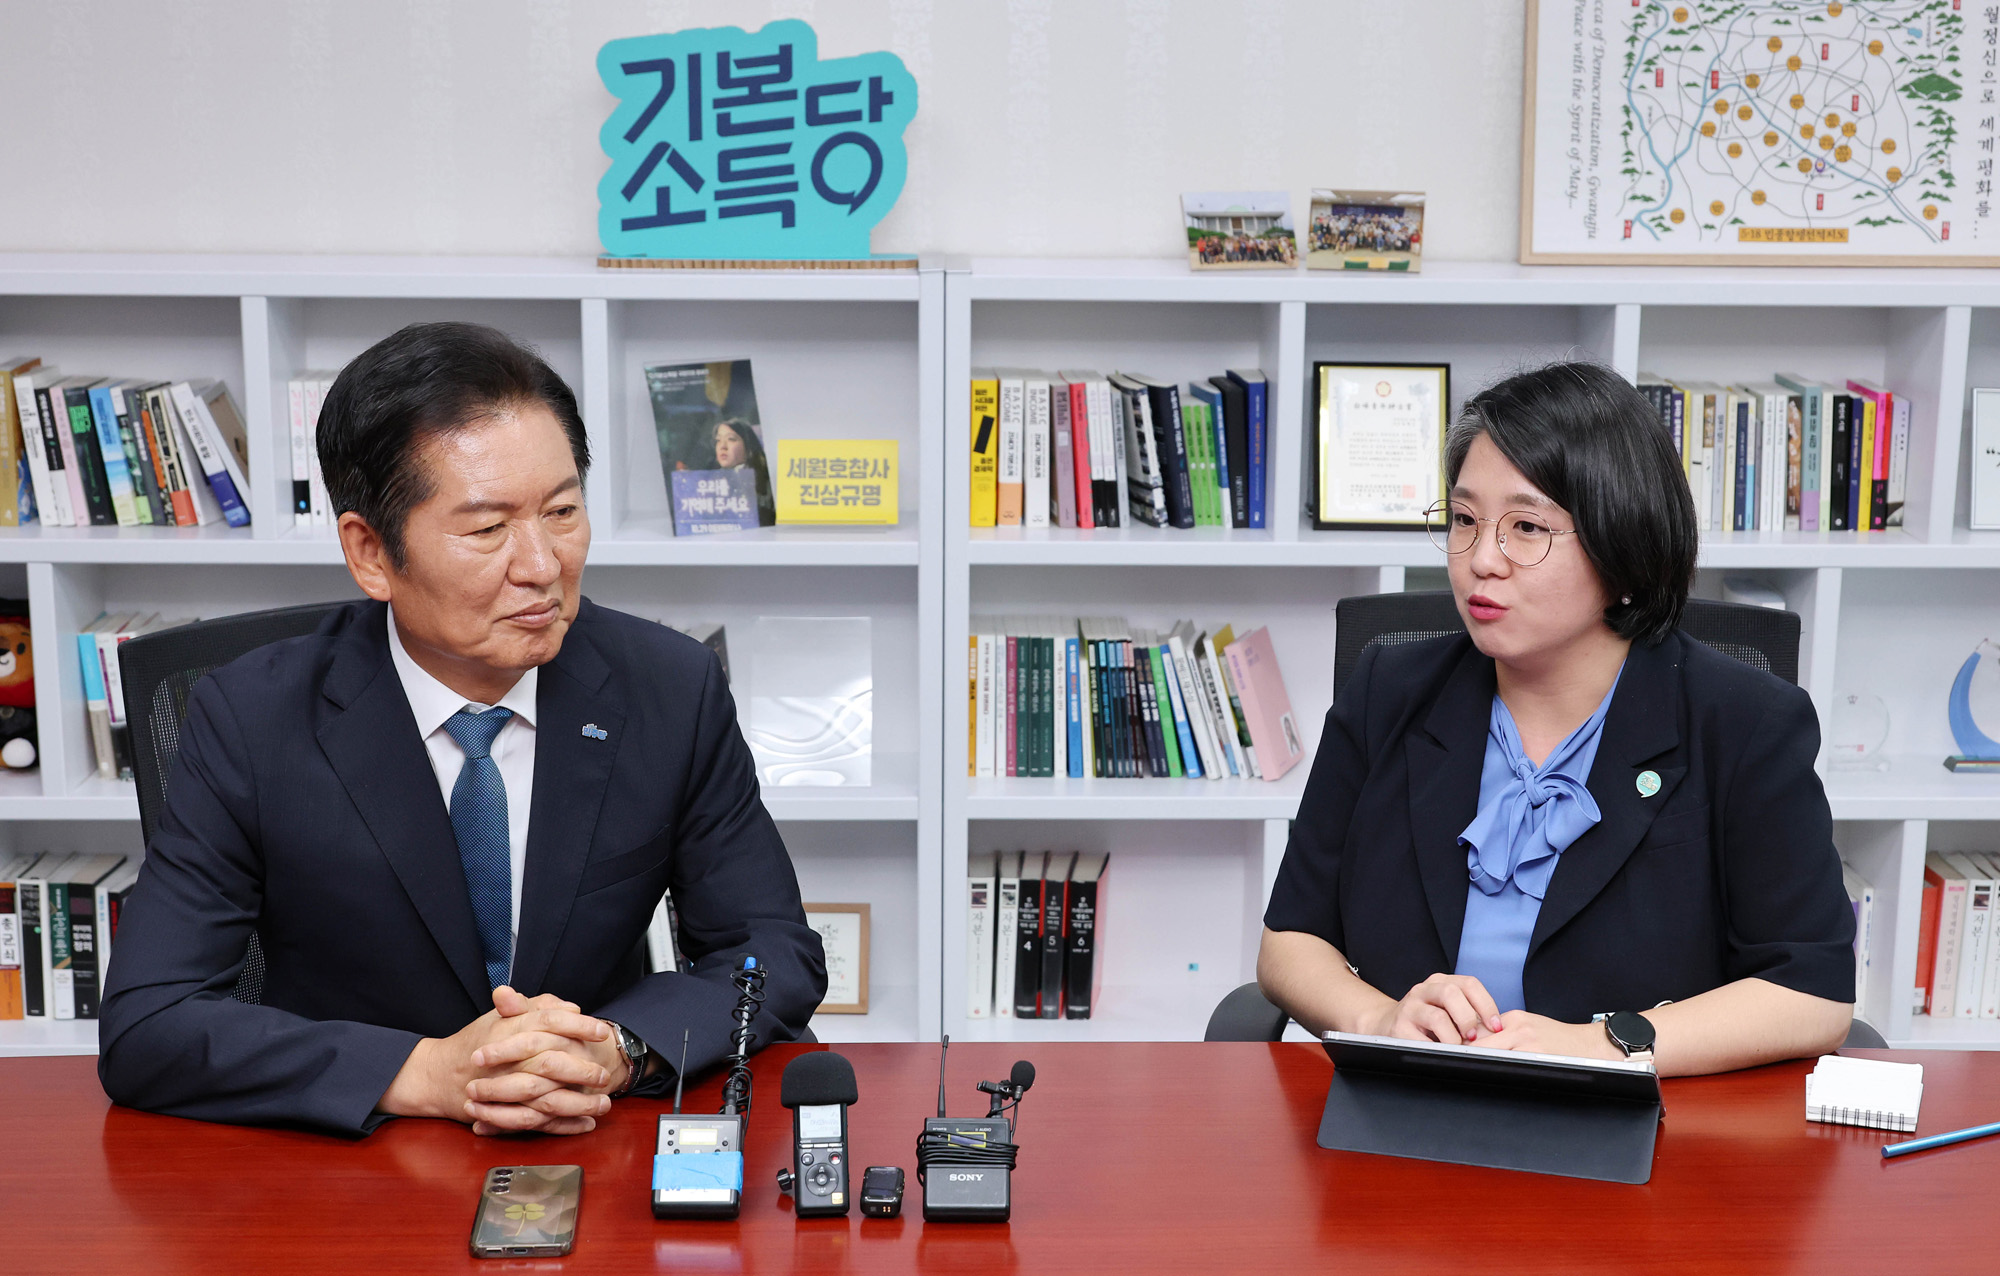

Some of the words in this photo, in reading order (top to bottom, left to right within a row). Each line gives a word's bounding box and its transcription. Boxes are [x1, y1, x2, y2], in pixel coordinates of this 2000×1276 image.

[1589, 28, 1607, 44] of
[1573, 42, 1586, 73] with
[620, 44, 798, 144] 기본
[1572, 78, 1586, 99] the
[1588, 45, 1605, 172] Democratization,
[1568, 103, 1584, 142] Spirit
[1566, 147, 1583, 165] of
[1584, 176, 1601, 239] Gwangju
[1003, 387, 1011, 423] INCOME
[1029, 389, 1037, 425] INCOME
[1039, 389, 1047, 425] BASIC
[787, 458, 890, 479] 세월호참사
[800, 484, 881, 506] 진상규명
[1024, 941, 1032, 951] 4
[1049, 935, 1056, 945] 5
[1078, 937, 1085, 947] 6
[949, 1173, 984, 1181] SONY
